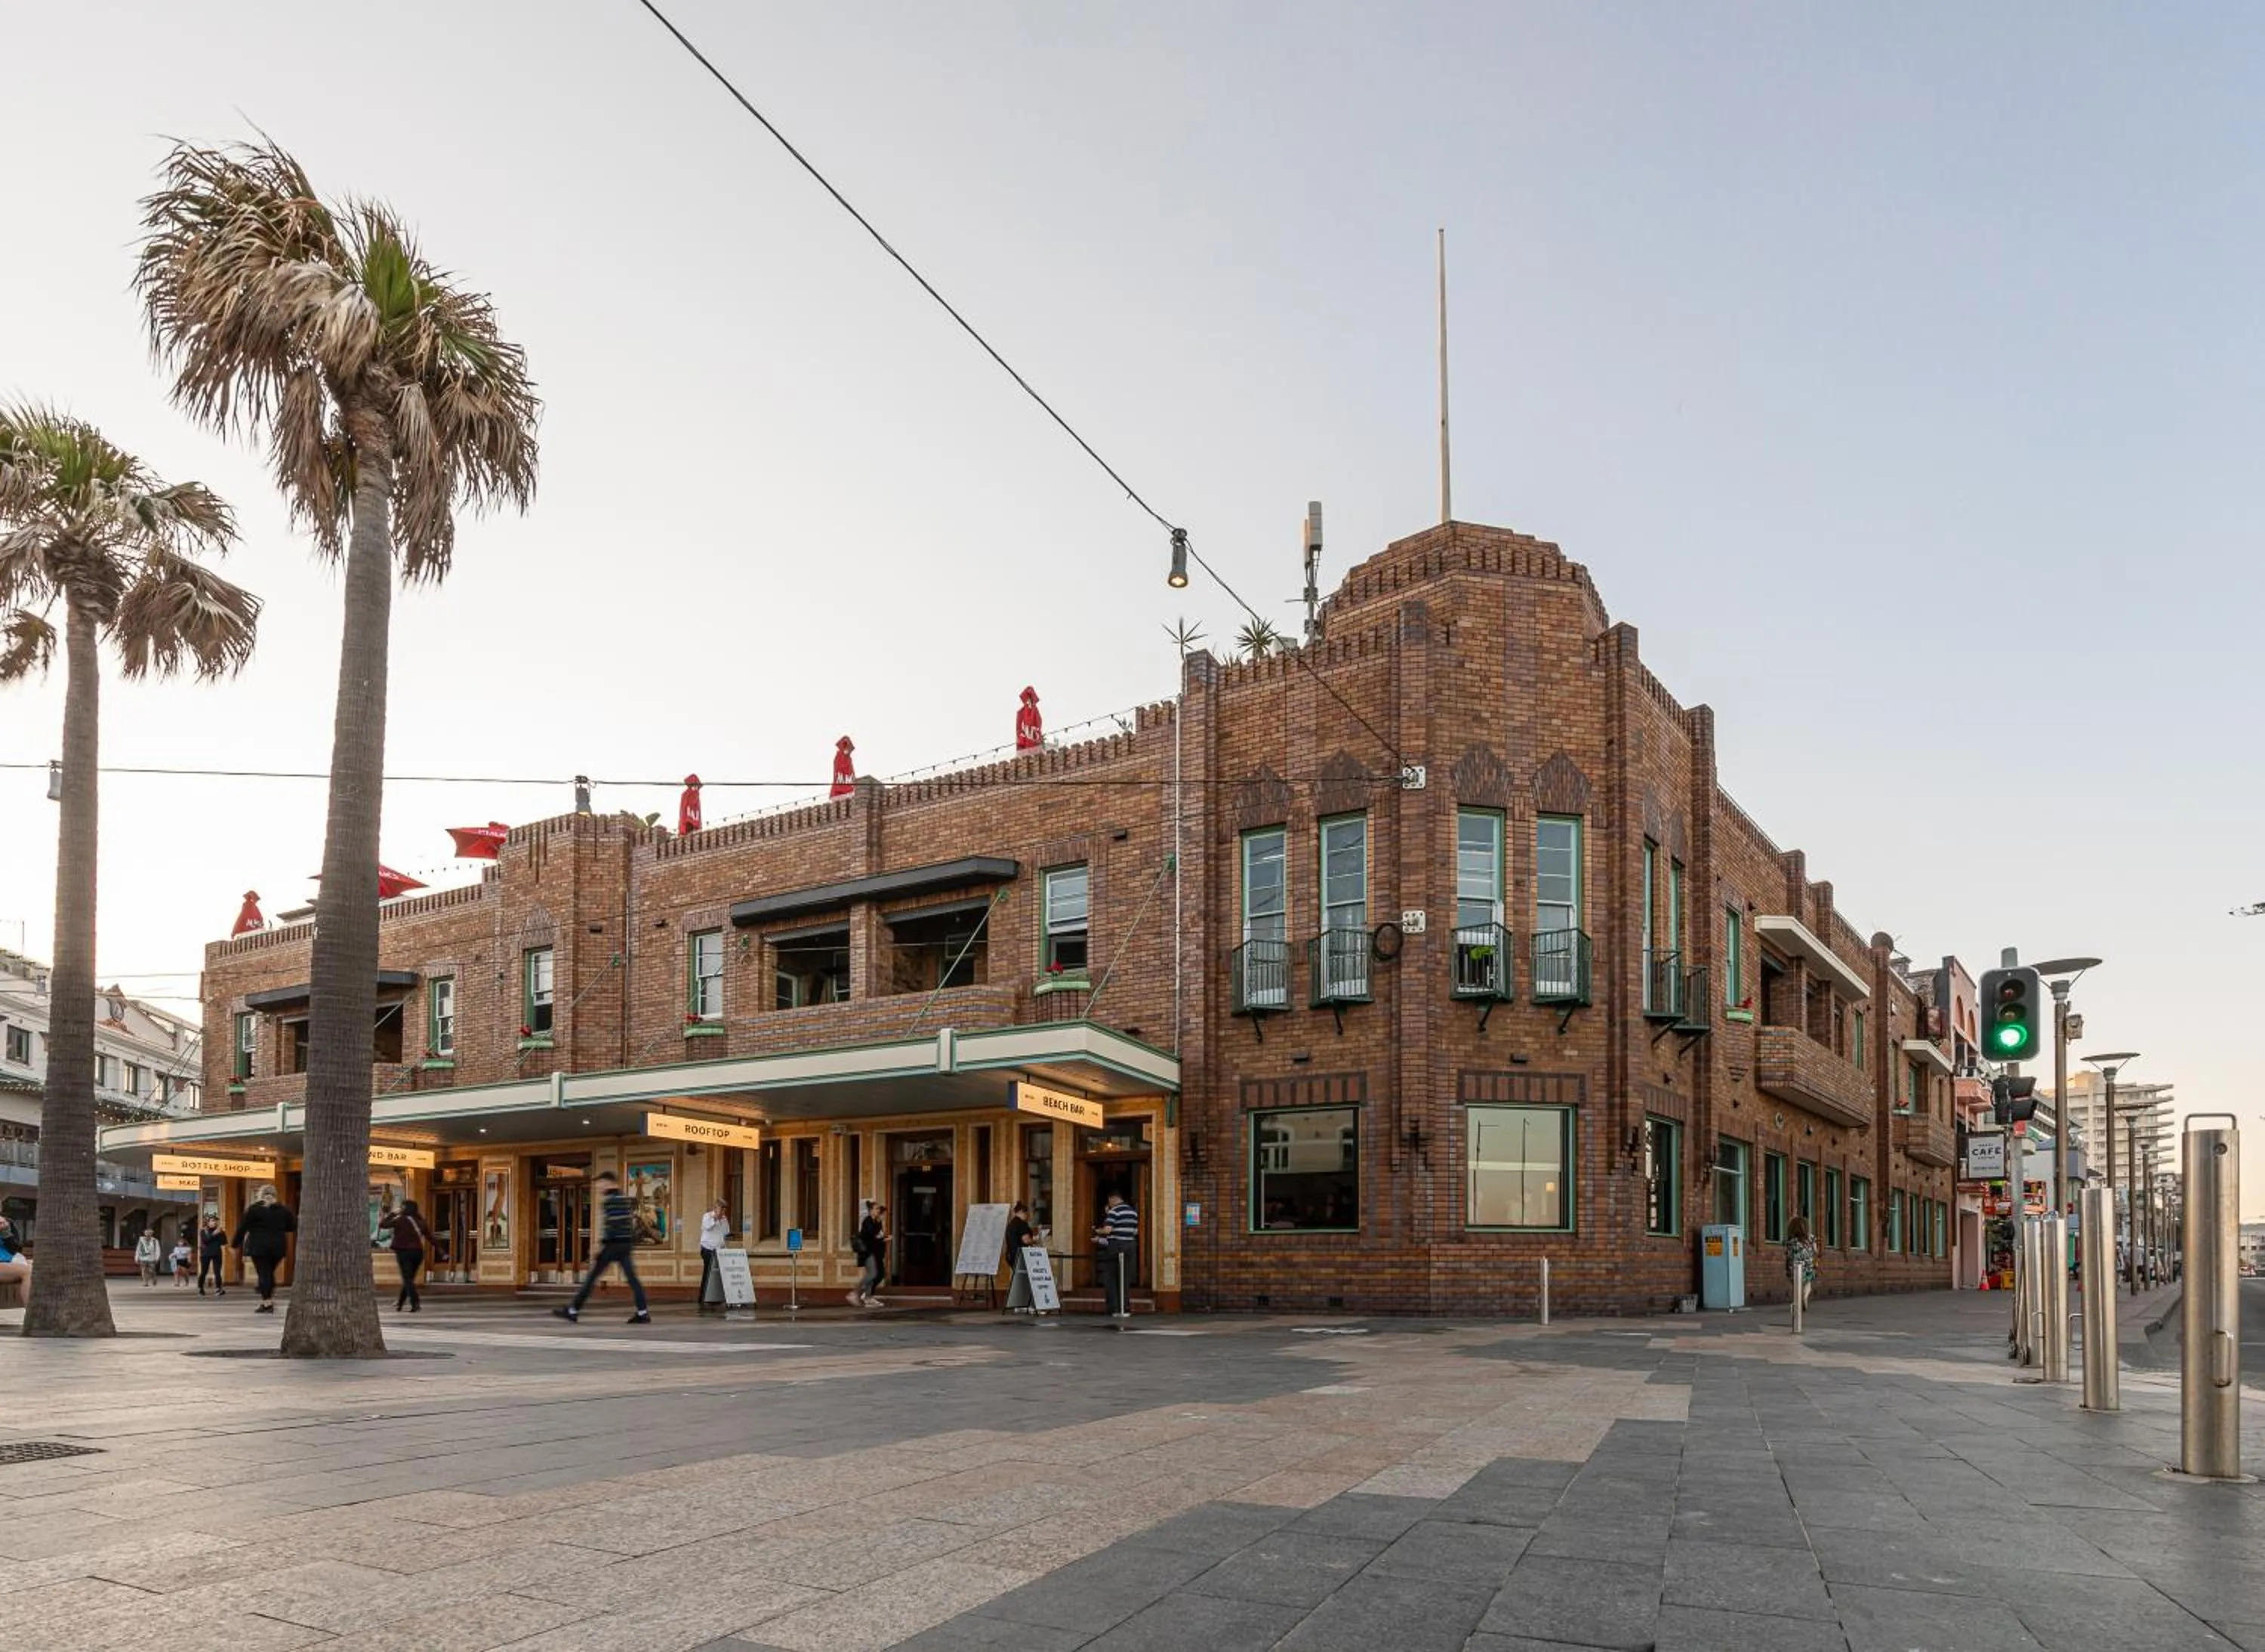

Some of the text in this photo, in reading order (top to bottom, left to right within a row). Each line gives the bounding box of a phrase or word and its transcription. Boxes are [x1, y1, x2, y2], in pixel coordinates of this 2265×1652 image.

[1043, 1096, 1085, 1116] BEACH BAR
[685, 1123, 730, 1138] ROOFTOP
[387, 1152, 407, 1160] BAR
[1971, 1147, 2002, 1156] CAFE
[181, 1160, 220, 1171] BOTTLE
[223, 1163, 251, 1172] SHOP
